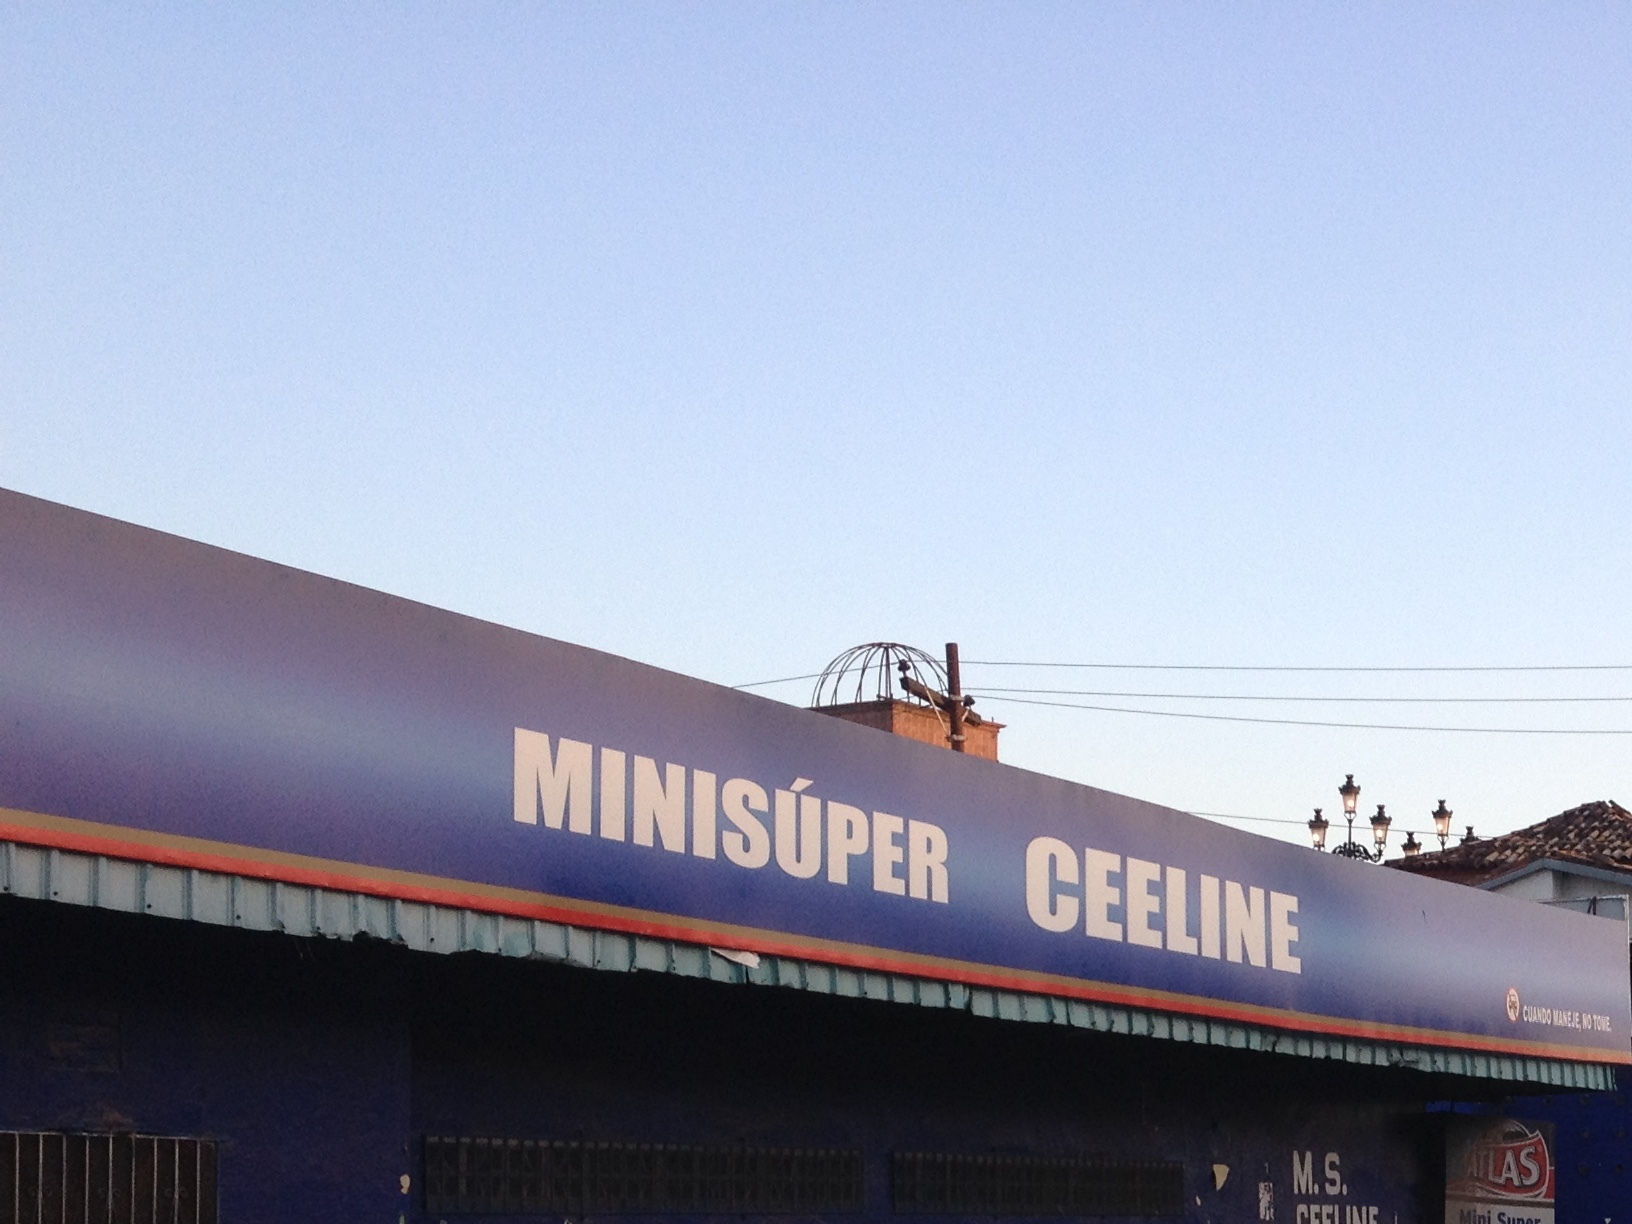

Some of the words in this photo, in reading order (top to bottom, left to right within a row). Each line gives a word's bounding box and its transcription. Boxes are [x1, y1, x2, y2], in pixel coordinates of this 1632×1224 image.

[513, 726, 950, 904] MINISÚPER
[1025, 836, 1302, 975] CEELINE
[1522, 1005, 1552, 1026] CUANDO
[1582, 1013, 1592, 1031] NO
[1292, 1149, 1320, 1195] M.
[1324, 1151, 1348, 1196] S.
[1466, 1144, 1541, 1188] ATLAS
